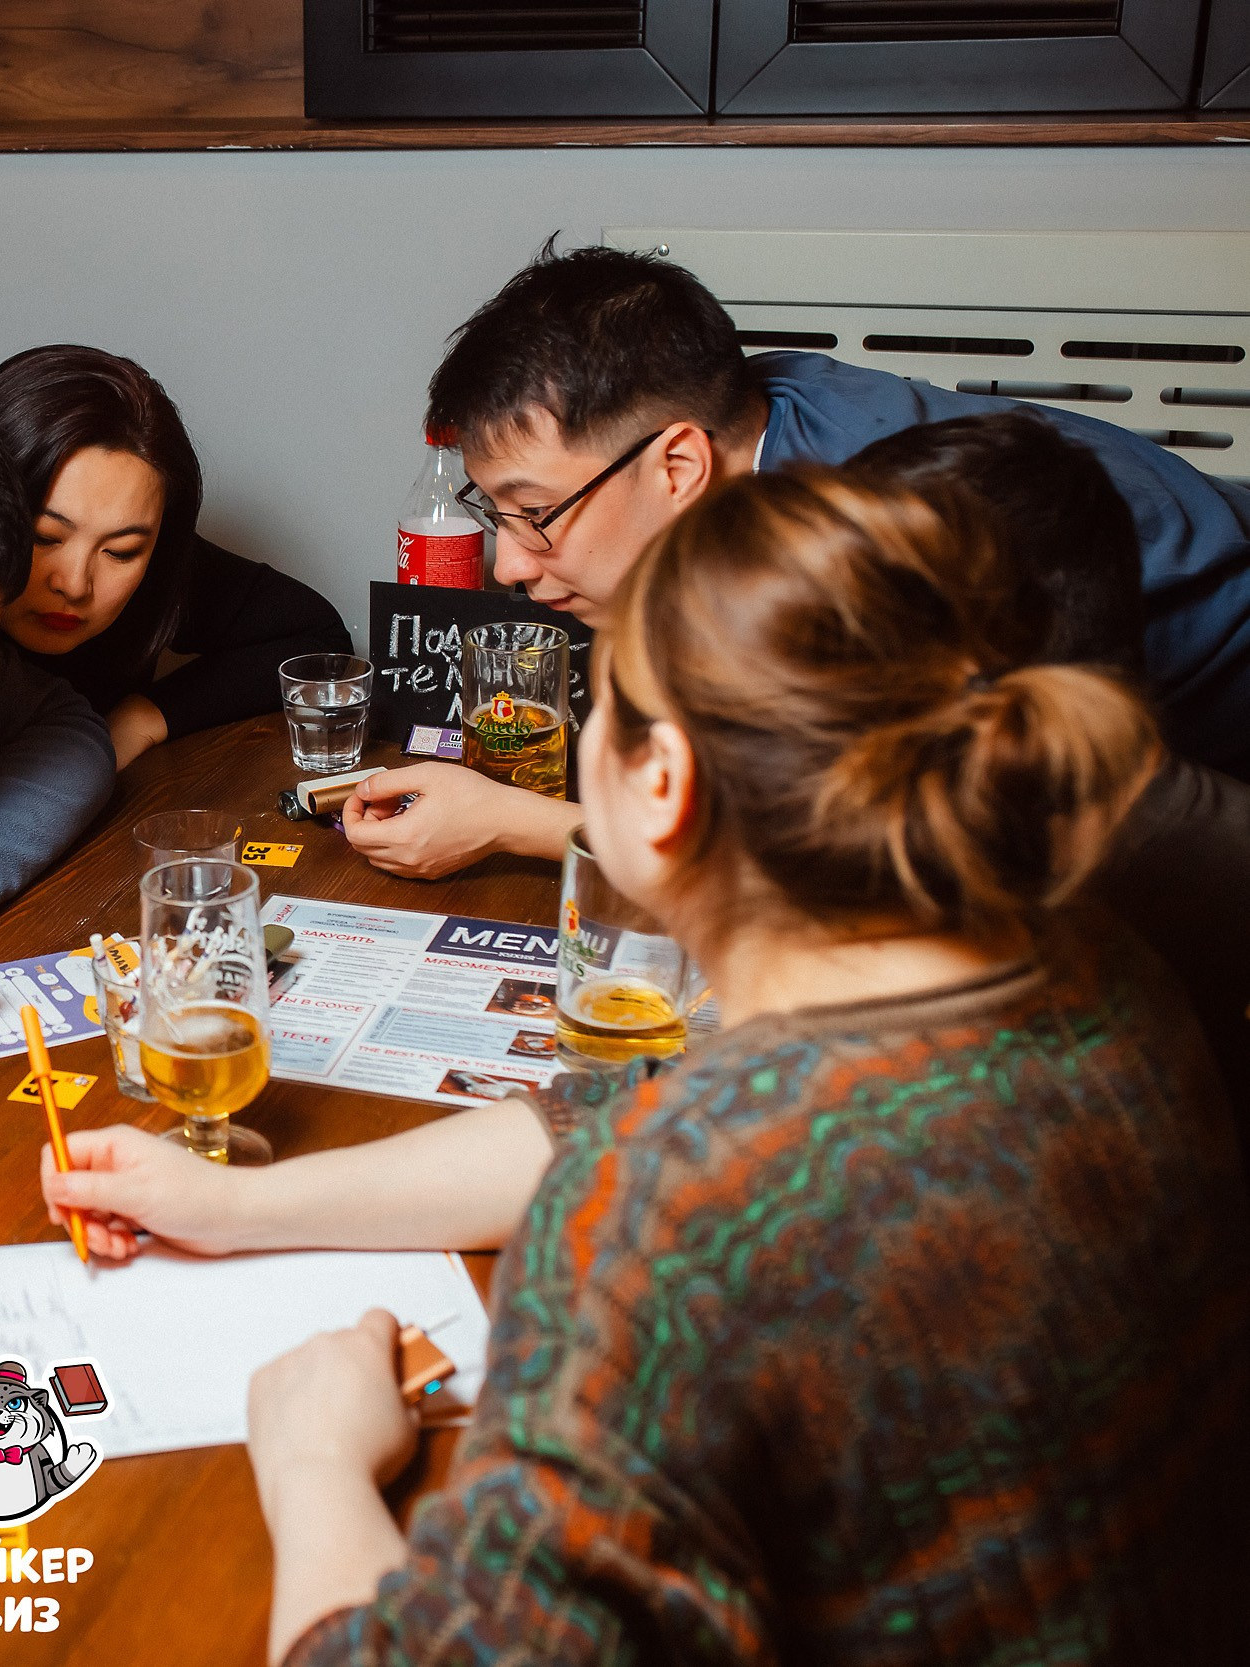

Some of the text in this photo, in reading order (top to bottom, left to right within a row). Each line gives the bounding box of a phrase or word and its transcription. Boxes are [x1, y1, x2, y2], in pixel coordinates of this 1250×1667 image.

[243, 845, 271, 860] 35
[300, 929, 375, 944] ЗАКУСИТЬ
[424, 956, 559, 978] МЯСОМЕЖДУТЕС
[315, 1001, 365, 1013] СОУСЕ
[283, 1031, 332, 1044] ТЕСТЕ
[384, 1049, 415, 1058] BEST
